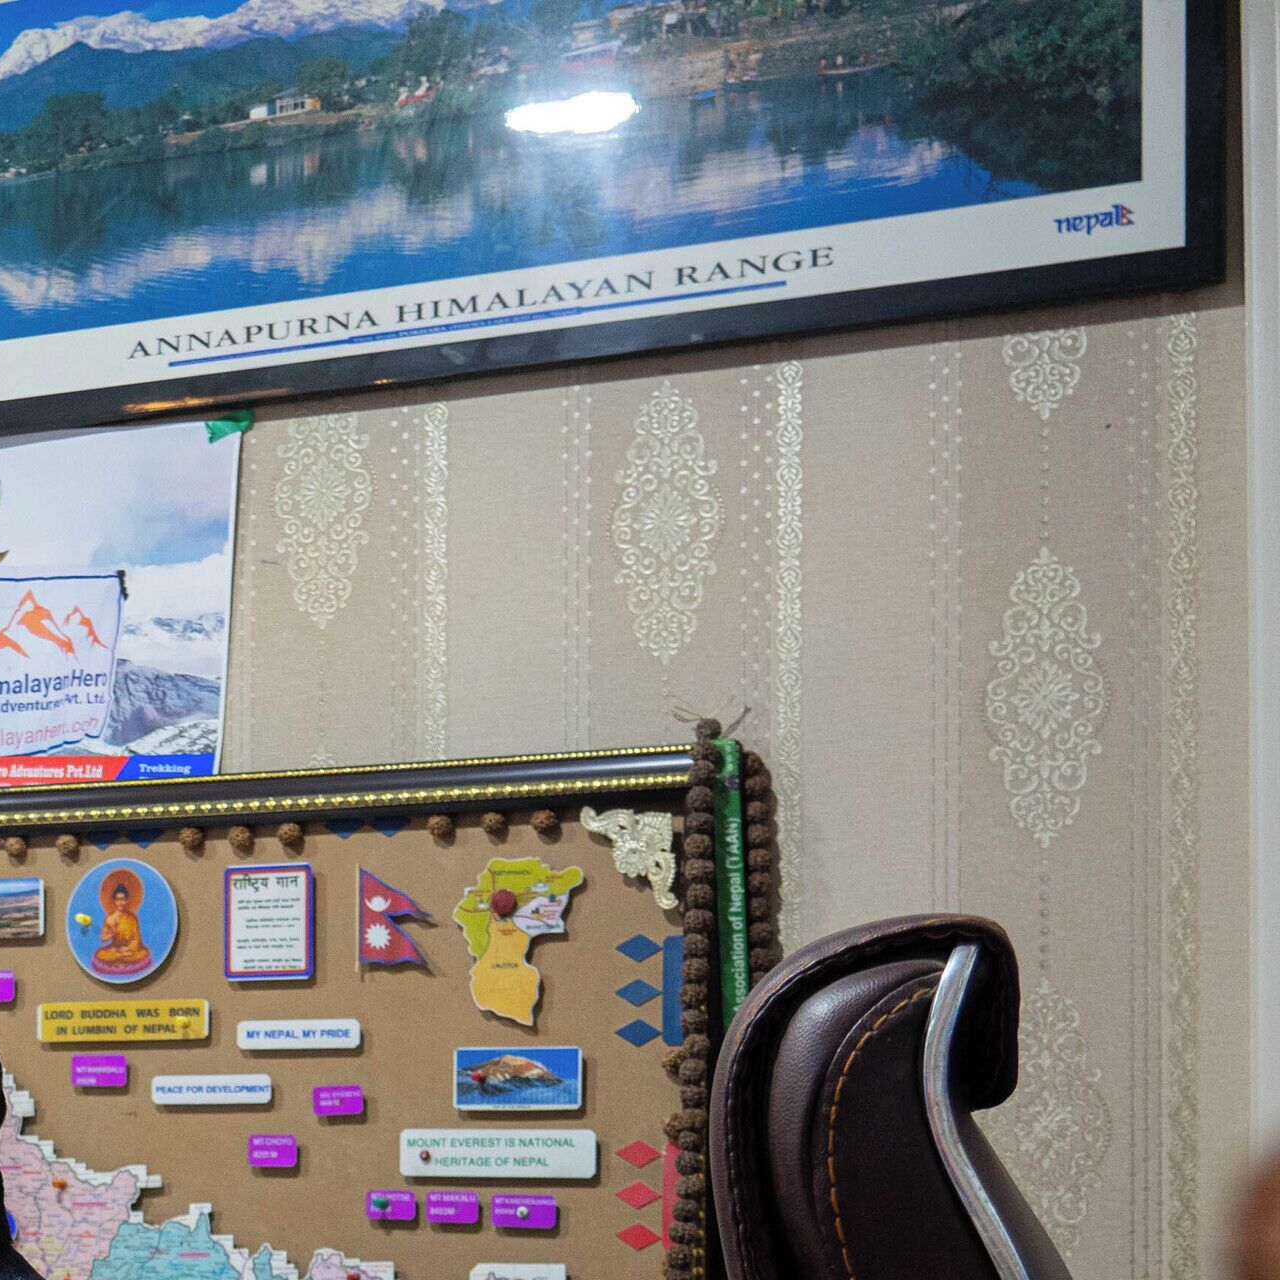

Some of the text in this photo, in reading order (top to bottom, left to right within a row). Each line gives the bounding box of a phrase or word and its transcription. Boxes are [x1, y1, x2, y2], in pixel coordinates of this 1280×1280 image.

[1053, 203, 1121, 235] nepal
[127, 310, 380, 359] ANNAPURNA
[396, 271, 655, 324] HIMALAYAN
[675, 246, 835, 287] RANGE
[139, 763, 192, 775] Trekking
[728, 872, 745, 912] Nepal
[728, 913, 744, 930] of
[45, 1007, 200, 1020] LORD BUDDHA WAS BORN
[56, 1023, 177, 1035] IN LUMBINI OF NEPAL
[246, 1029, 261, 1039] MY
[302, 1029, 318, 1038] MY
[320, 1028, 351, 1038] PRIDE
[156, 1084, 270, 1094] PEACE FOR DEVELOPMENT
[407, 1138, 576, 1148] MOUNT EVEREST IS NATIONAL
[434, 1157, 549, 1167] HERITAGE OF NEPAL
